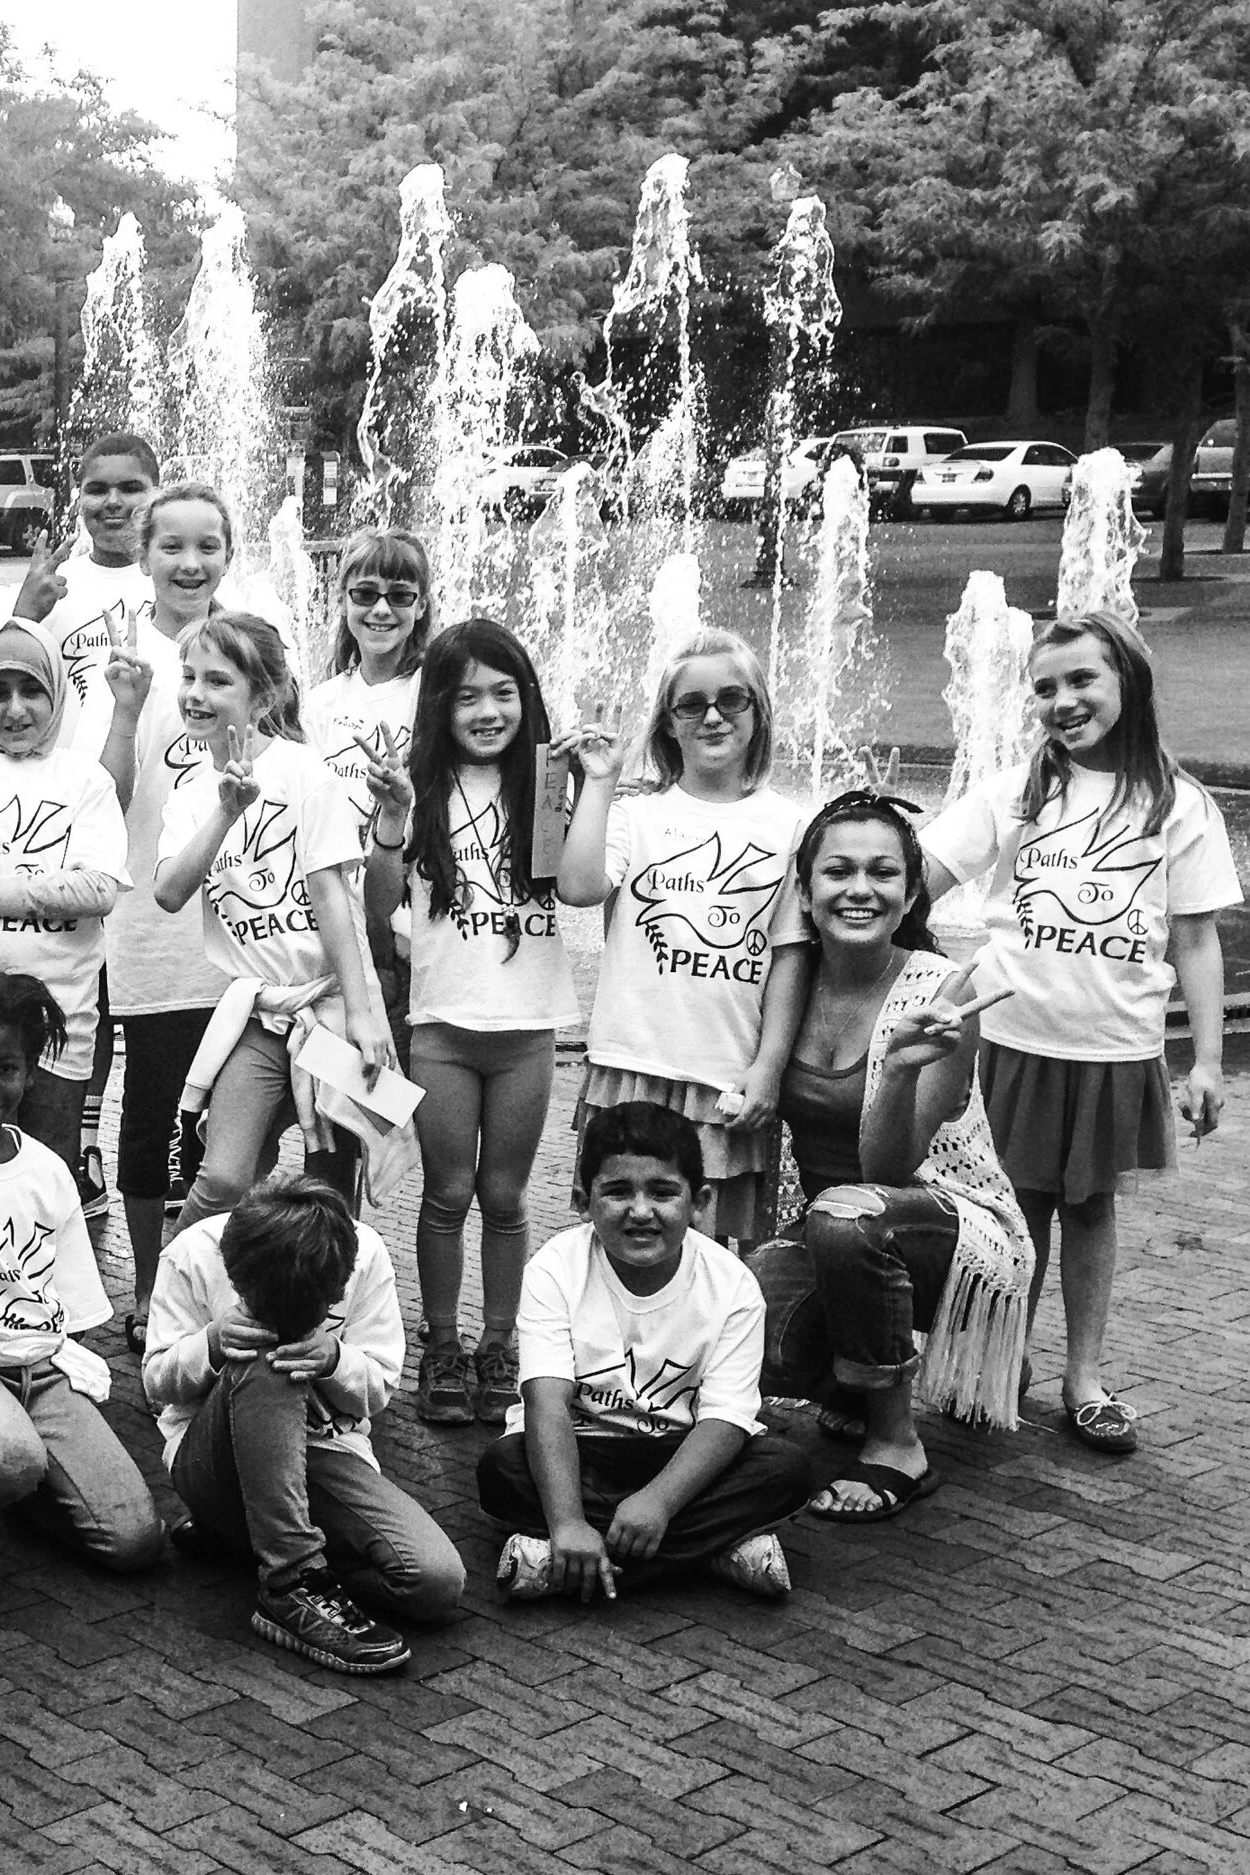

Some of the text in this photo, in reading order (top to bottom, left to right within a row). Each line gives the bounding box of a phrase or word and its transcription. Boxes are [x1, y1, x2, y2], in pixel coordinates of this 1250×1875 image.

[70, 632, 108, 655] Path
[214, 850, 243, 874] aths
[454, 842, 489, 861] aths
[1020, 848, 1079, 876] Paths
[248, 868, 276, 892] To
[648, 868, 705, 893] Paths
[1078, 881, 1114, 904] To
[235, 909, 319, 945] PEACE
[708, 905, 741, 928] To
[1034, 925, 1146, 963] PEACE
[670, 949, 763, 985] PEACE
[575, 1382, 634, 1410] Paths
